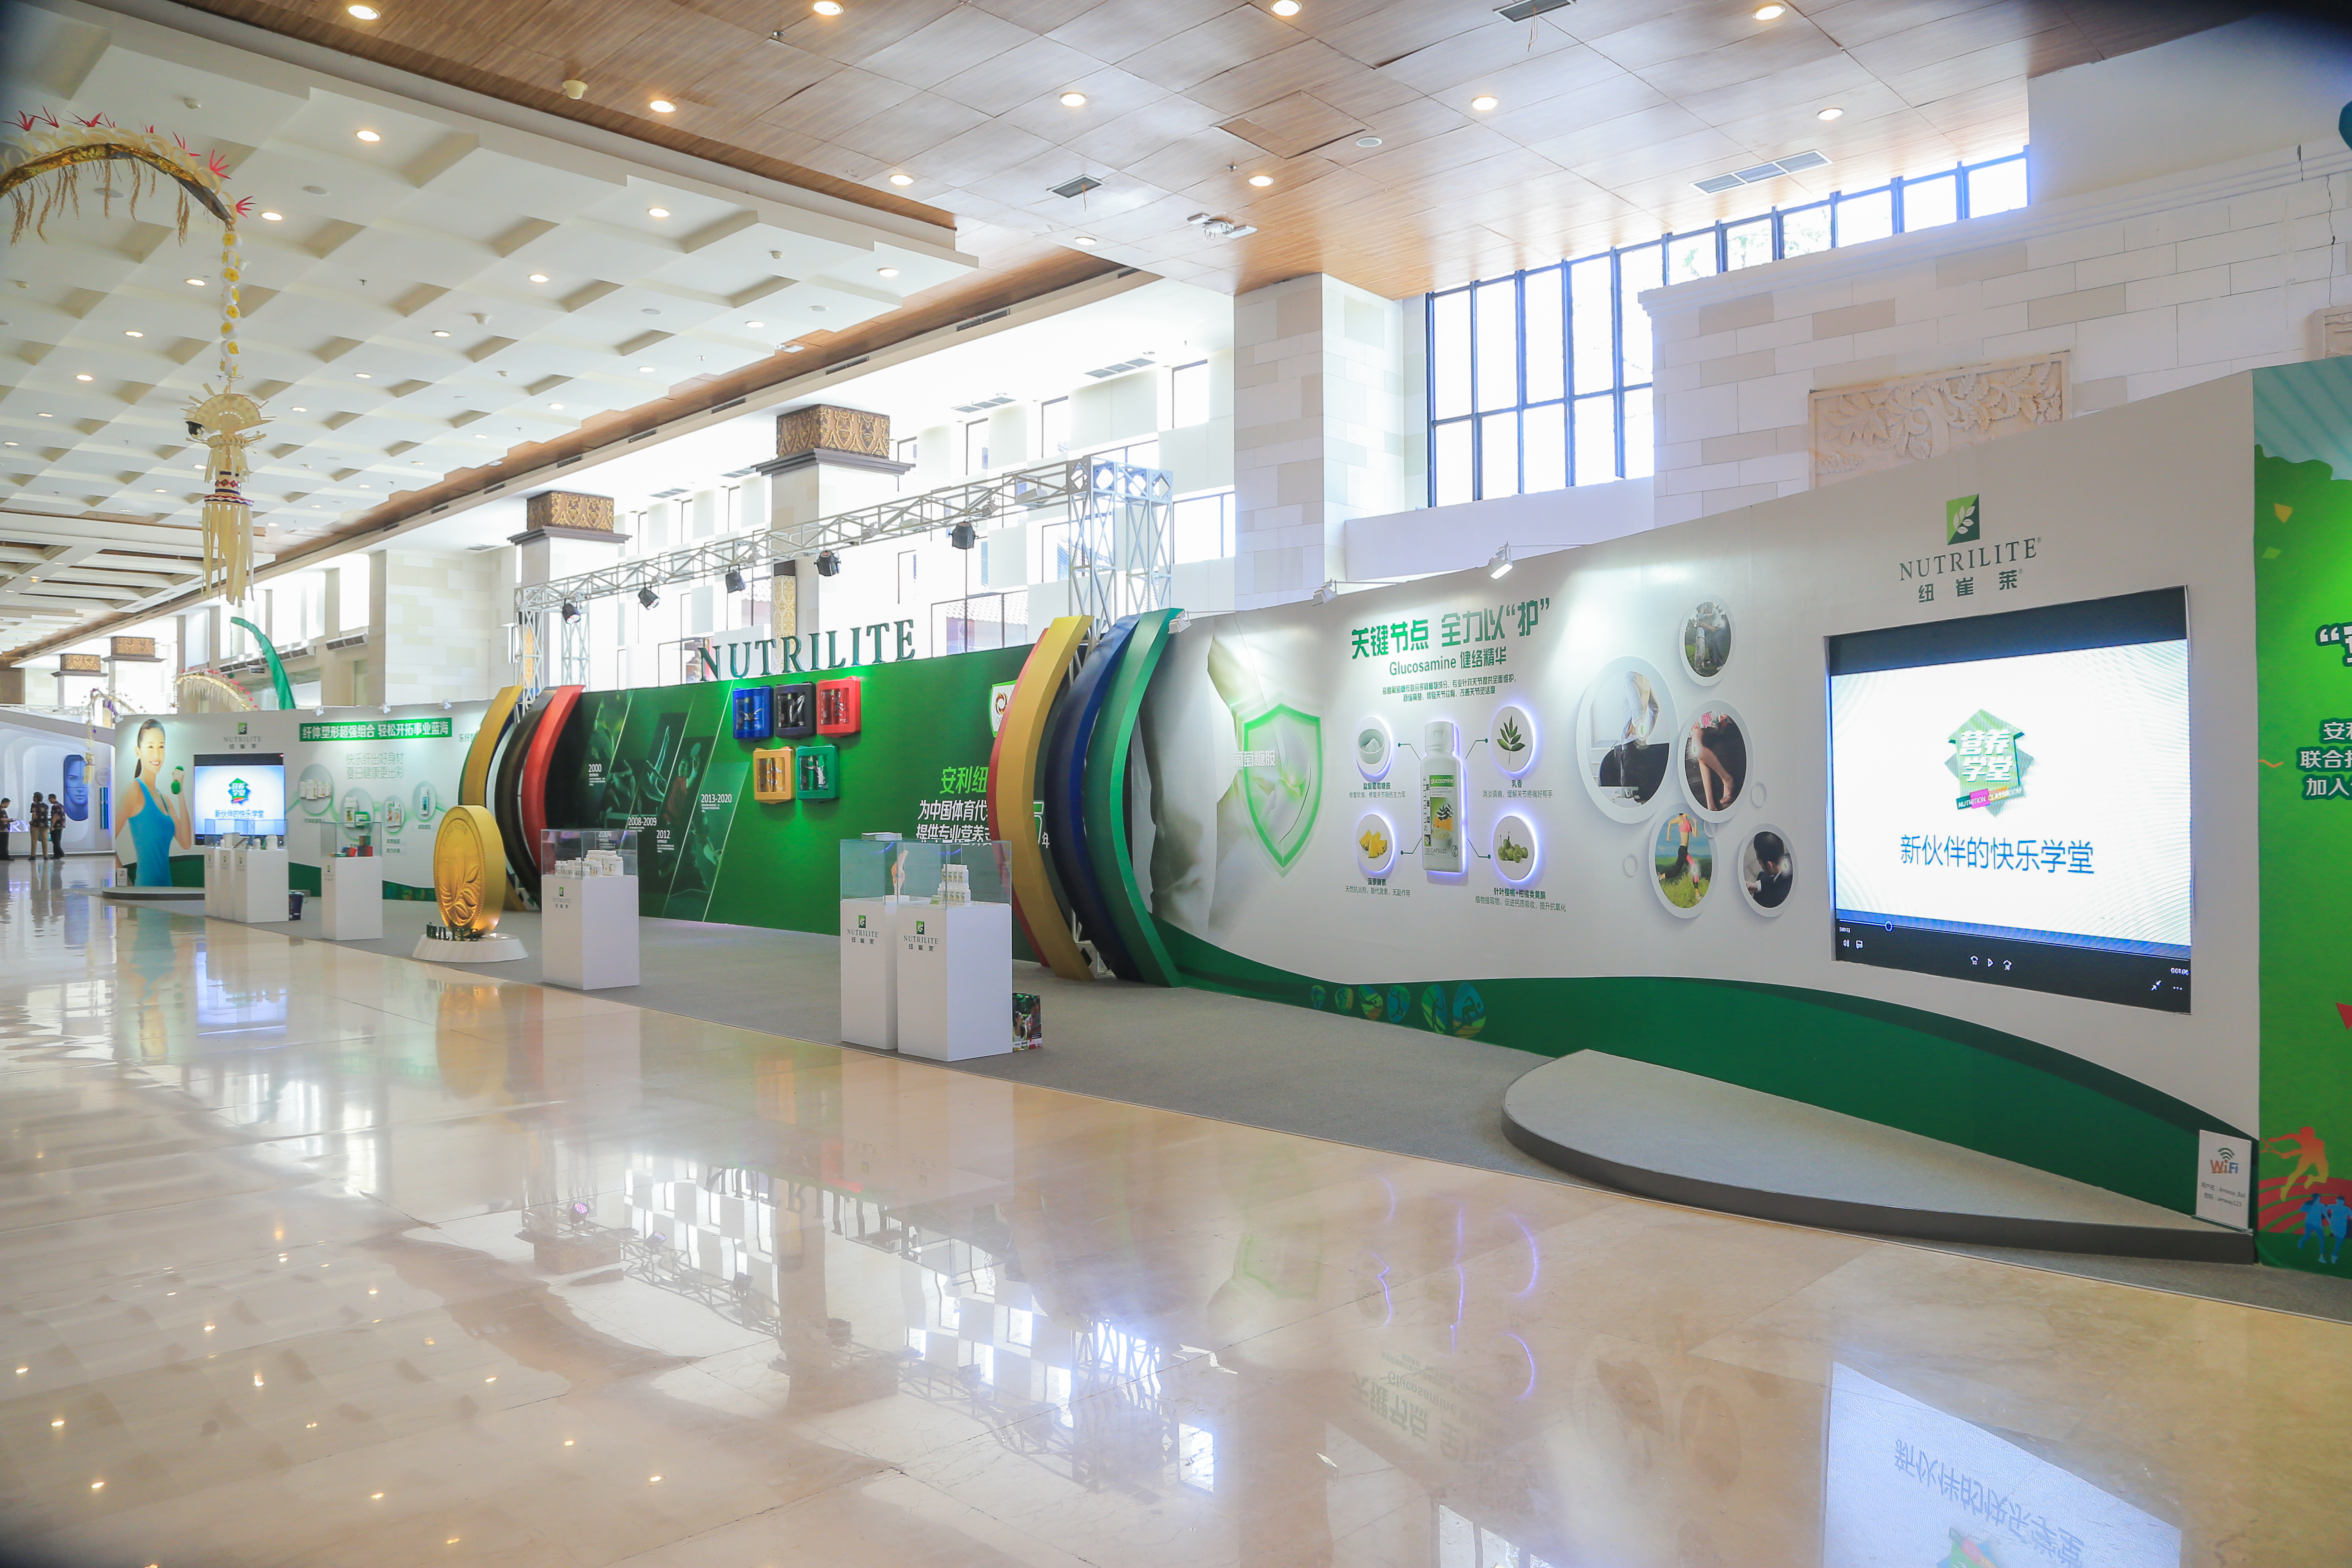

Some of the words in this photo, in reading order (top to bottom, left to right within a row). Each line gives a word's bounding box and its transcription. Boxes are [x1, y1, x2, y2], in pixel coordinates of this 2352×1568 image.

[1899, 538, 2037, 581] NUTRILITE
[1918, 569, 2017, 603] 纽崔莱
[1352, 619, 1429, 659] 关键节点
[698, 619, 916, 682] NUTRILITE
[1390, 655, 1456, 676] Glucosamine
[1460, 646, 1507, 669] 健络精华
[303, 724, 375, 740] 纤体塑形超强组合
[377, 721, 449, 738] 轻松开拓事业蓝海
[1960, 729, 2010, 756] 营养
[588, 764, 602, 772] 2000
[1233, 750, 1276, 768] 葡萄糖胺
[1962, 756, 2014, 783] 学堂
[1511, 779, 1522, 788] 乳香
[2306, 778, 2352, 796] 加入
[701, 794, 732, 803] 2013-2020
[1958, 796, 1986, 808] NUTRITION
[917, 799, 988, 821] 为中国体育代
[628, 817, 657, 826] 2008-2009
[657, 830, 670, 839] 2012
[1901, 834, 2094, 874] 新伙伴的快乐学堂
[847, 929, 878, 938] NUTRILITE
[904, 935, 939, 944] NUTRILITE
[2210, 1159, 2239, 1174] WiFi
